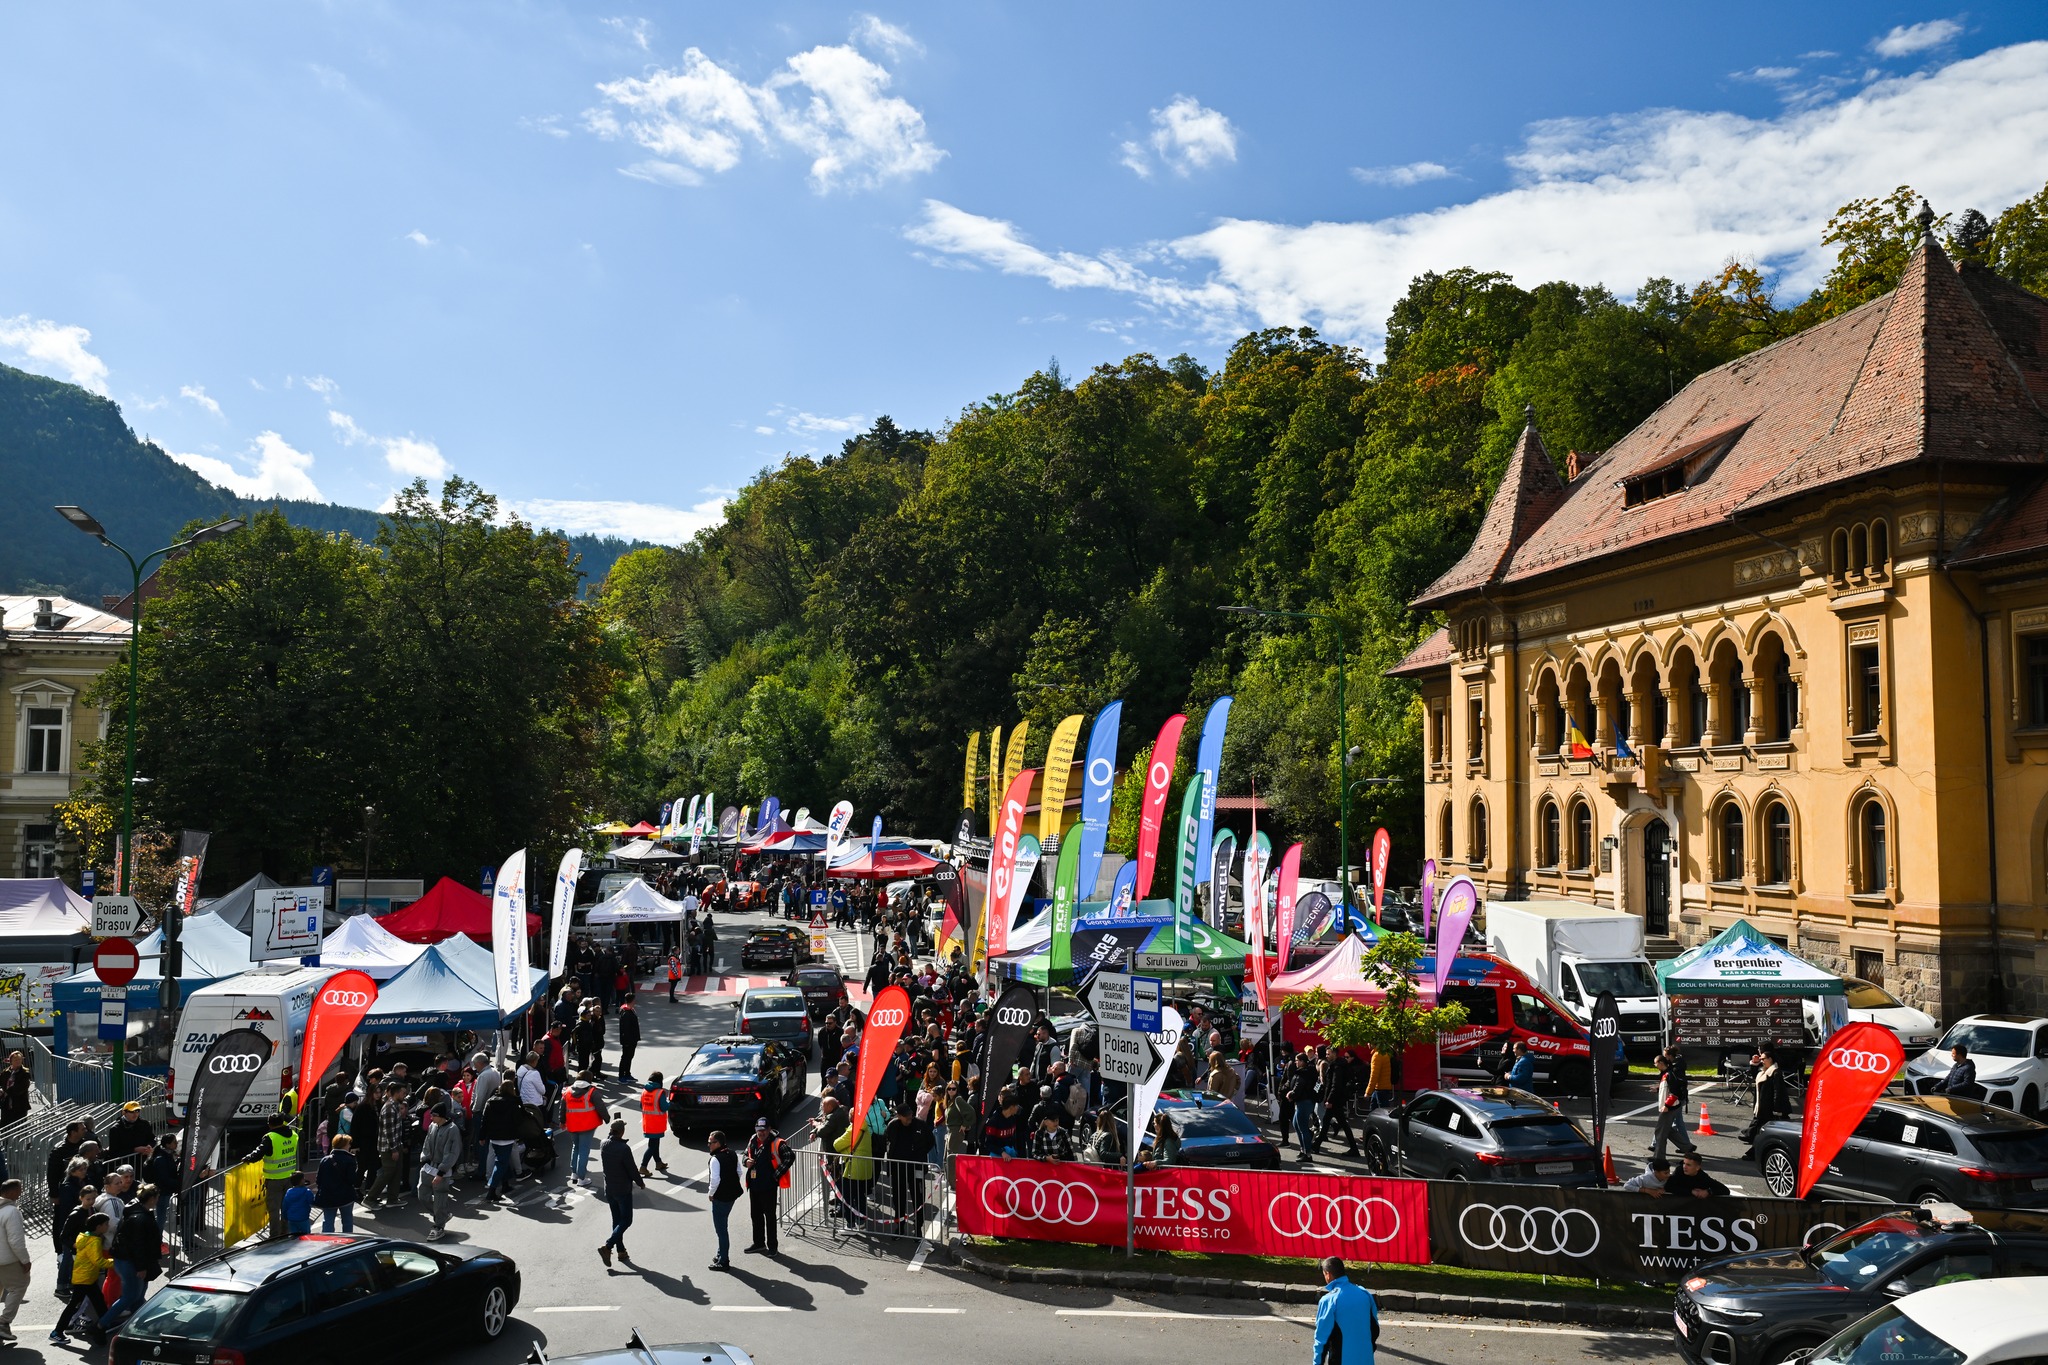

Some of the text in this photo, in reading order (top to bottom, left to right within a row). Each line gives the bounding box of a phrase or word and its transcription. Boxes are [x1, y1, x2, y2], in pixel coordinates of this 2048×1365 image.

[96, 902, 129, 915] Poiana
[1302, 897, 1327, 929] TECNET
[96, 918, 132, 933] Brașov
[1089, 942, 1110, 961] BCR
[1164, 956, 1188, 967] Livezii
[1223, 962, 1245, 970] bankin
[1714, 958, 1783, 969] Bergenbier
[292, 994, 304, 1011] 208
[1104, 991, 1125, 1001] BOARDING
[1098, 1000, 1130, 1014] DEBARCARE
[365, 1013, 462, 1027] DANNY UNGUR Racing
[1101, 1011, 1127, 1021] DEBOARDING
[1137, 1013, 1155, 1021] AUTOCAR
[1104, 1032, 1139, 1055] Poiana
[1440, 1028, 1488, 1046] Milwaukee
[308, 1045, 316, 1073] Vorsprung
[1104, 1053, 1143, 1078] Brașov
[236, 1104, 263, 1114] 08
[191, 1126, 201, 1157] Vorsprung
[197, 1087, 205, 1109] Technik
[1810, 1121, 1819, 1160] Vorsprung
[1134, 1224, 1231, 1239] www.tess.ro
